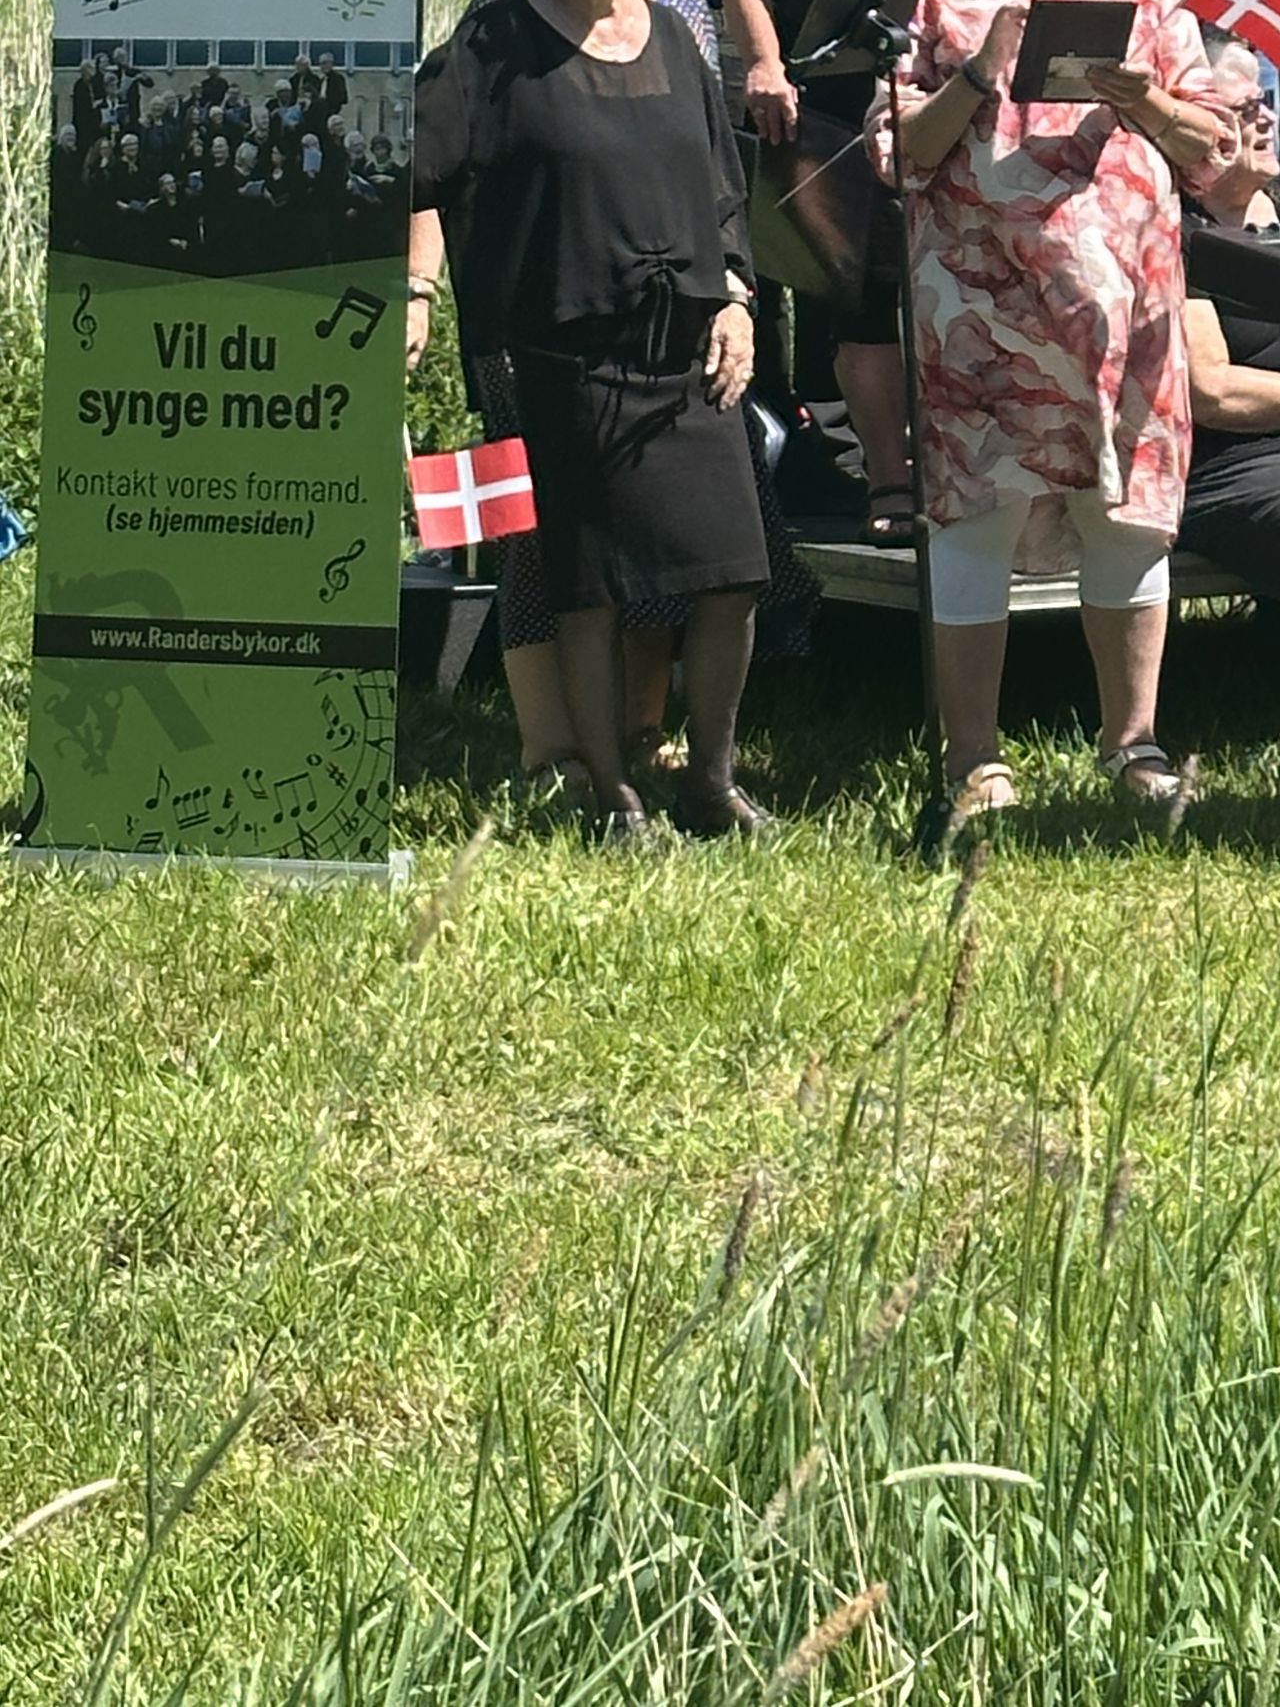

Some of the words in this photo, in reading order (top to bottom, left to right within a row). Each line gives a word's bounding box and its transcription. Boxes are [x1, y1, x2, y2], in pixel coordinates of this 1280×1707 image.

[154, 322, 207, 370] Vil
[221, 325, 277, 371] du
[79, 389, 207, 438] synge
[221, 384, 350, 430] med?
[56, 467, 158, 498] Kontakt
[165, 474, 239, 500] vores
[247, 472, 368, 504] formand.
[106, 504, 143, 532] (se
[148, 505, 315, 539] hjemmesiden)
[91, 626, 322, 656] www.Randersbykor.dk
